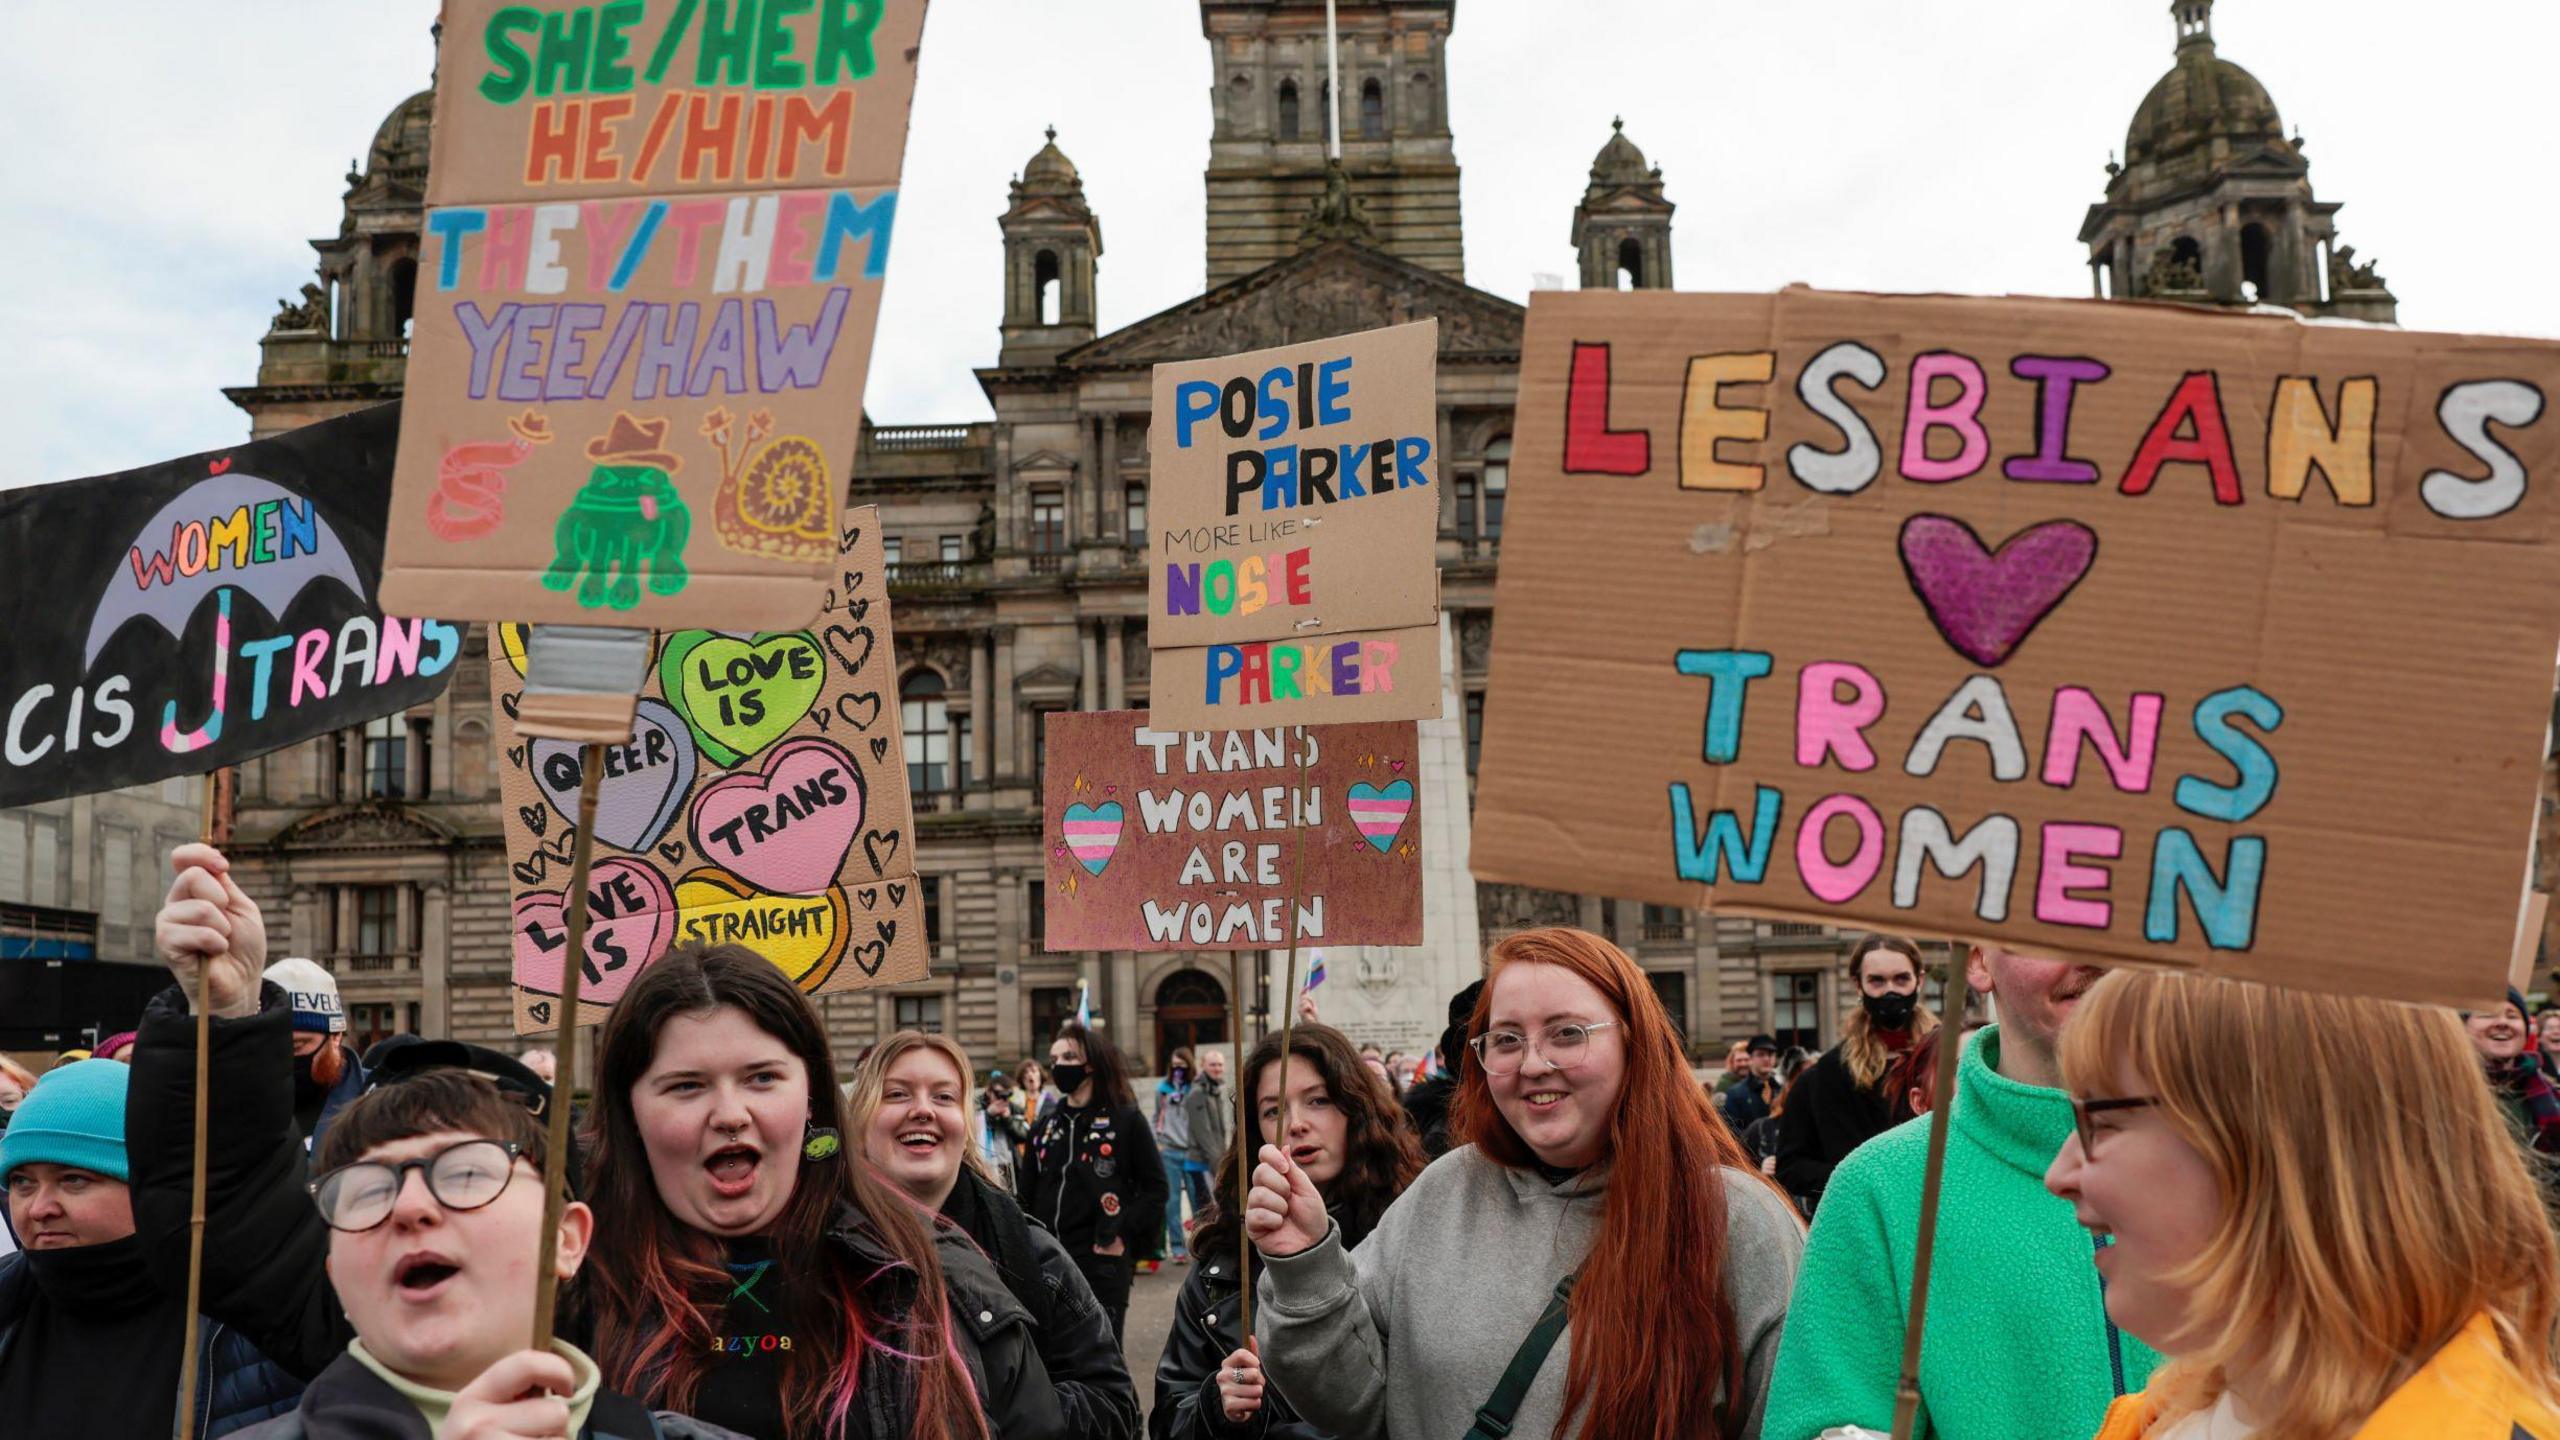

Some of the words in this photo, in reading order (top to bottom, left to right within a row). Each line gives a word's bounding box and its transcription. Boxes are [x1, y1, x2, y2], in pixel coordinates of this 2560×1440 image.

[479, 0, 885, 104] SHE/HER
[524, 90, 855, 185] HE/HIM
[429, 190, 899, 292] THEY/THEM
[454, 286, 851, 400] YEE/HAW
[1176, 356, 1352, 448] POSIE
[1561, 340, 2543, 519] LESBIANS
[1225, 436, 1431, 516] PARKER
[130, 498, 318, 590] WOMEN
[1164, 524, 1241, 555] MORE
[1249, 519, 1296, 543] LIKE
[1167, 547, 1312, 617] NOSIE
[5, 675, 134, 766] CIS
[240, 615, 460, 720] TRANS
[699, 647, 815, 691] LOVE
[719, 689, 765, 727] IS
[1205, 640, 1399, 705] PARKER
[1134, 726, 1320, 776] TRANS
[1673, 648, 2283, 823] TRANS
[709, 769, 847, 856] TRANS
[1136, 786, 1323, 834] WOMEN
[1178, 840, 1282, 886] ARE
[1666, 781, 2266, 951] WOMEN
[685, 905, 828, 942] STRAIGHT
[1141, 895, 1325, 945] WOMEN
